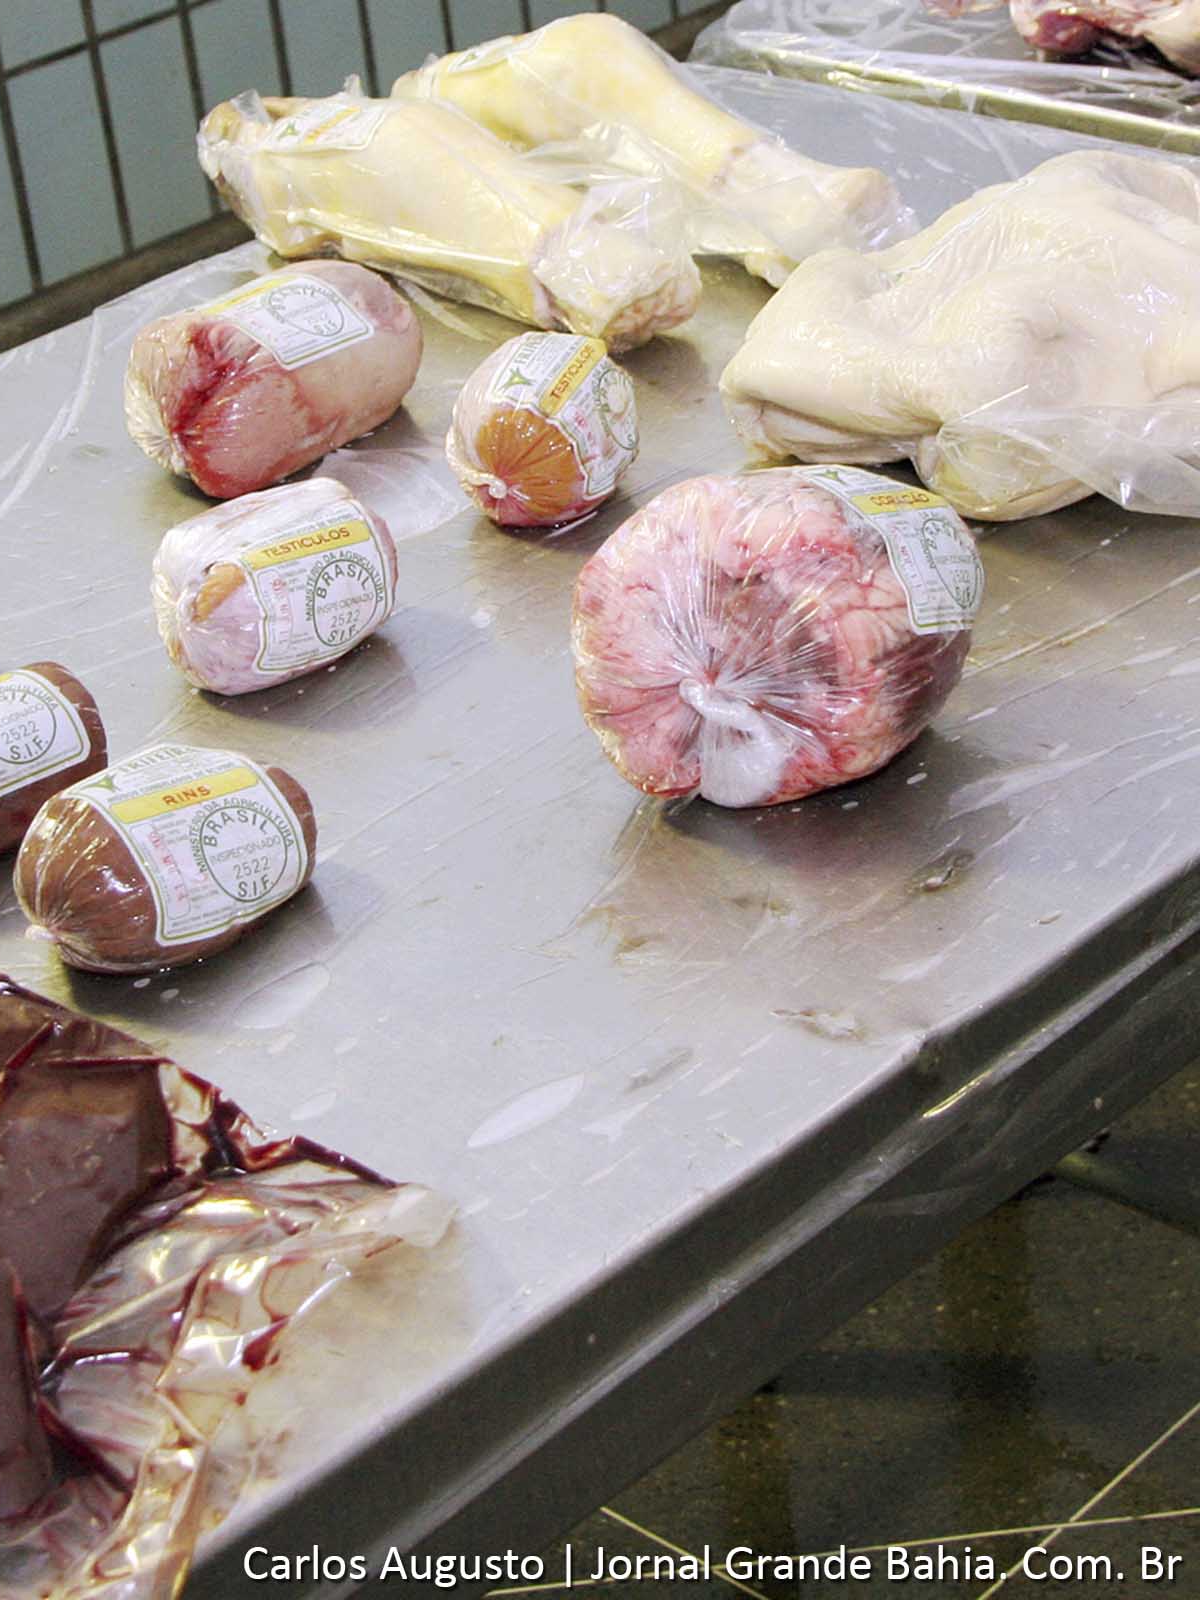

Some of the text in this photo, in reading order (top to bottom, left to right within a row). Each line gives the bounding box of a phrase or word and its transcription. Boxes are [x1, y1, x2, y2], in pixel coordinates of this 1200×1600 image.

[316, 563, 370, 599] BRASIL
[1, 720, 40, 745] 2522
[162, 786, 211, 807] RINS
[203, 809, 269, 847] BRASIL
[233, 855, 271, 880] 2522
